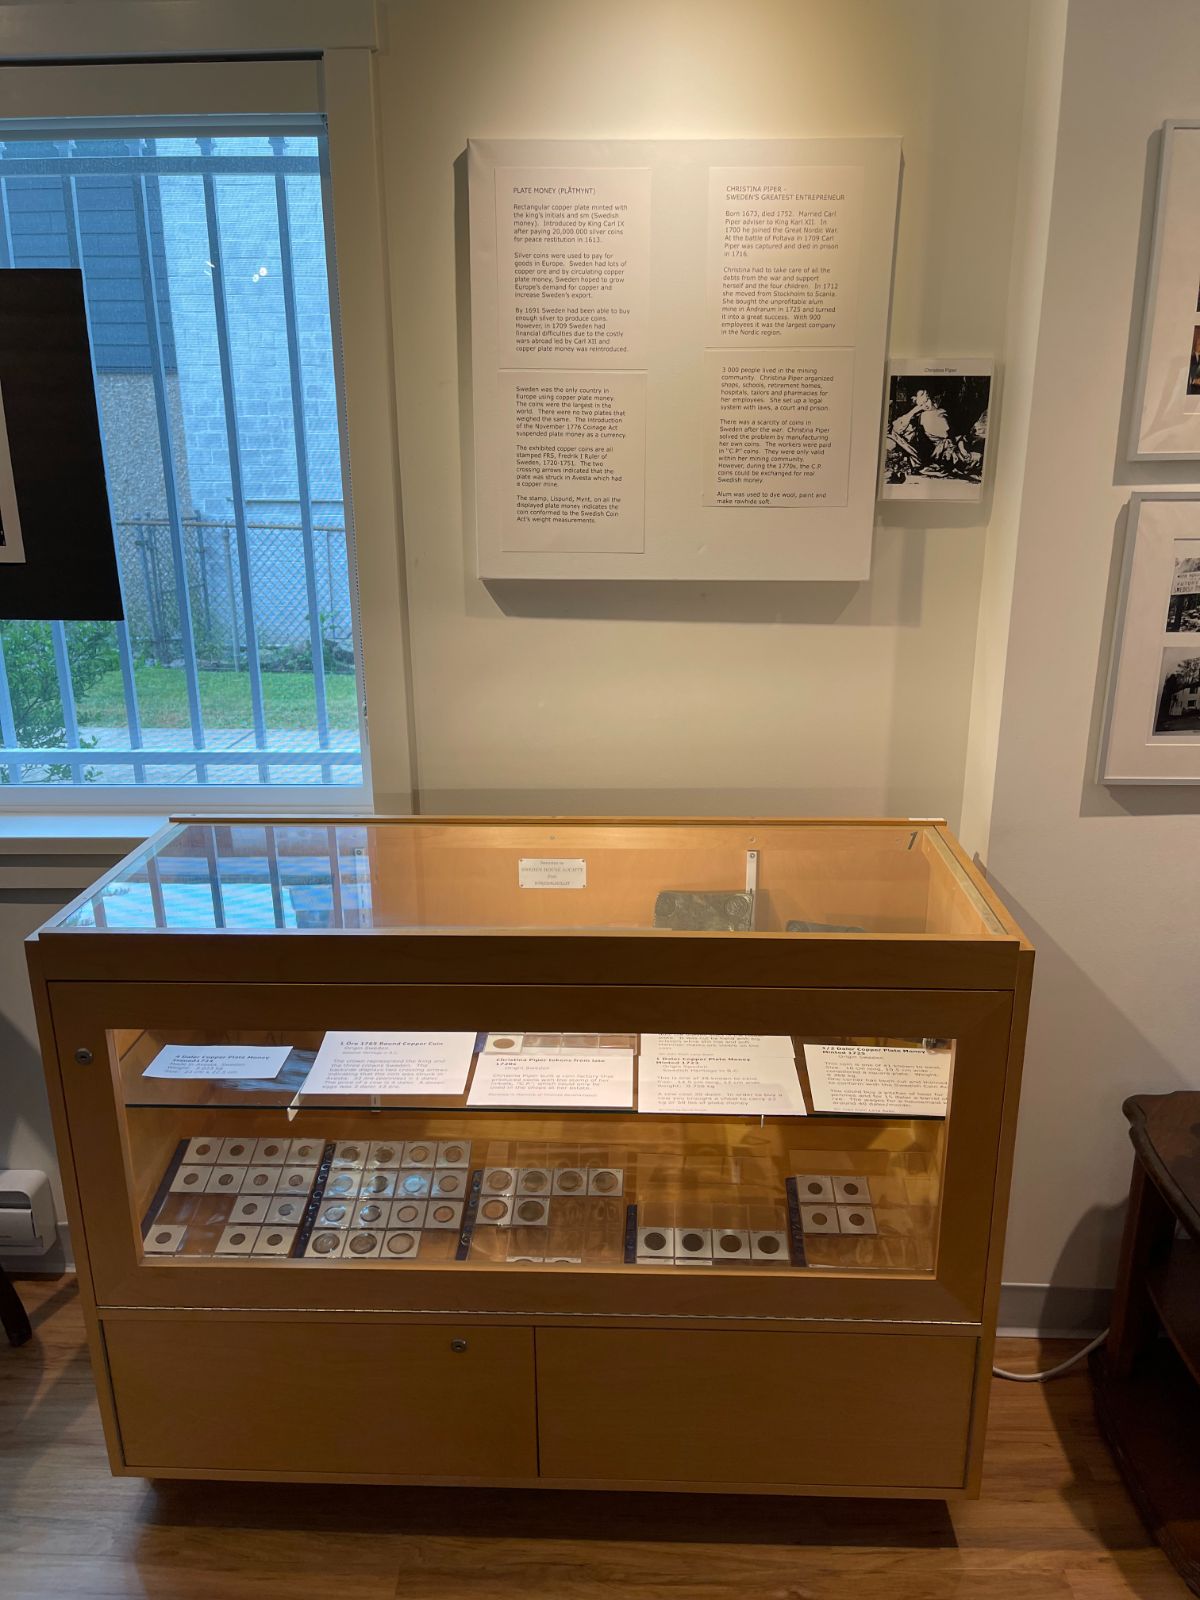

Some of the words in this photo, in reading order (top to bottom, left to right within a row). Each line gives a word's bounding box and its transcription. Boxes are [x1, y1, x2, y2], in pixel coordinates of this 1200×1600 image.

[513, 204, 550, 212] Rectangular
[574, 204, 590, 212] plate
[525, 212, 544, 220] king's
[751, 227, 771, 235] joined
[724, 243, 740, 251] Piper
[755, 243, 783, 251] captured
[579, 387, 601, 395] country
[907, 831, 919, 850] 1
